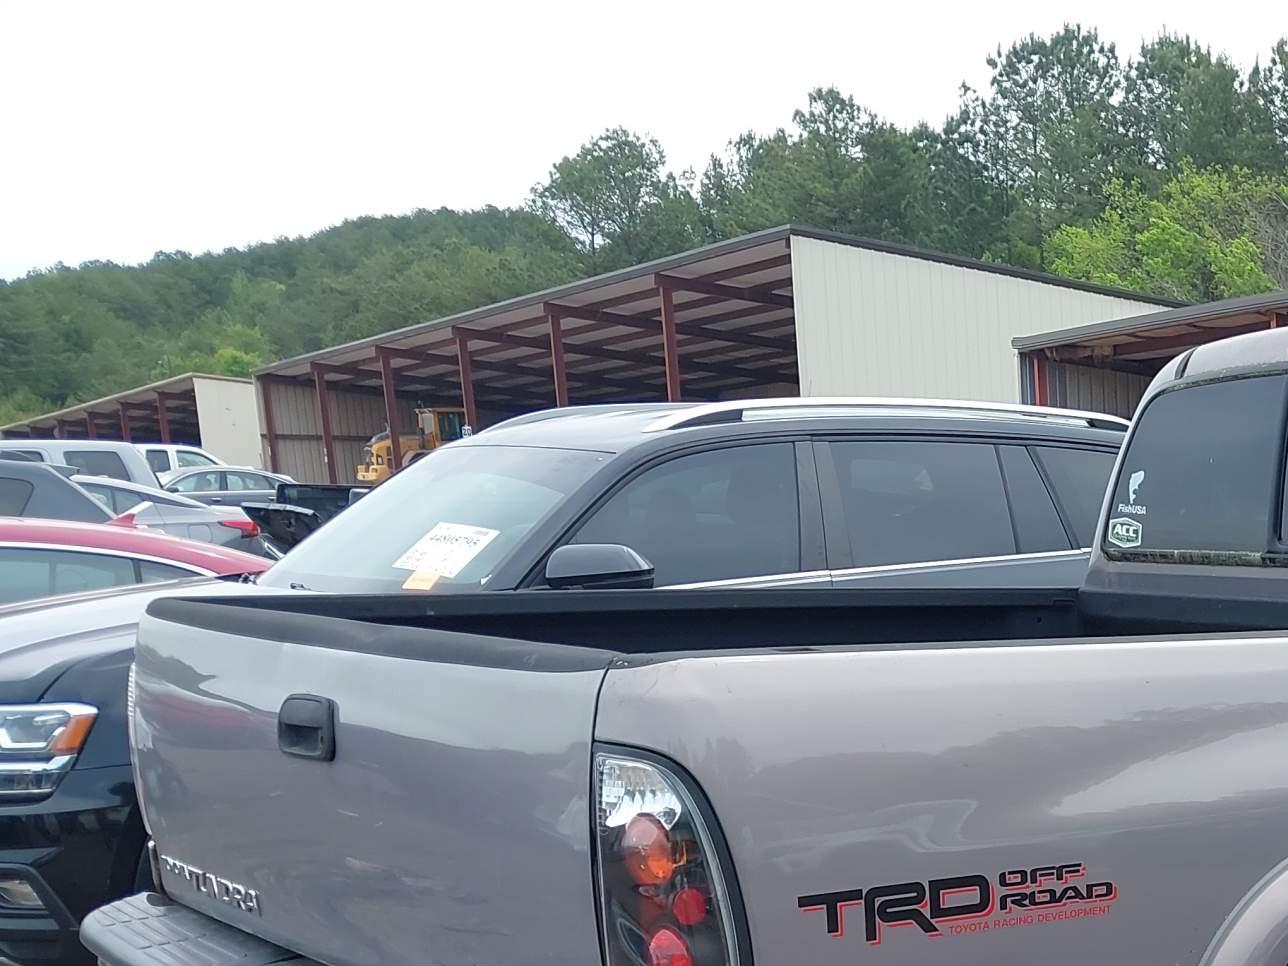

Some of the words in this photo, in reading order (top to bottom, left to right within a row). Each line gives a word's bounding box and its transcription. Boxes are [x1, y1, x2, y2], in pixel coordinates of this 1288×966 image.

[1112, 523, 1138, 537] ACC
[187, 866, 262, 917] TUNDRA
[998, 862, 1087, 890] OFF
[798, 873, 995, 945] TRD
[999, 881, 1118, 914] ROAD
[949, 920, 990, 936] TOYOTA
[993, 915, 1034, 929] RACING
[1037, 904, 1113, 922] DEVELOPMENT
